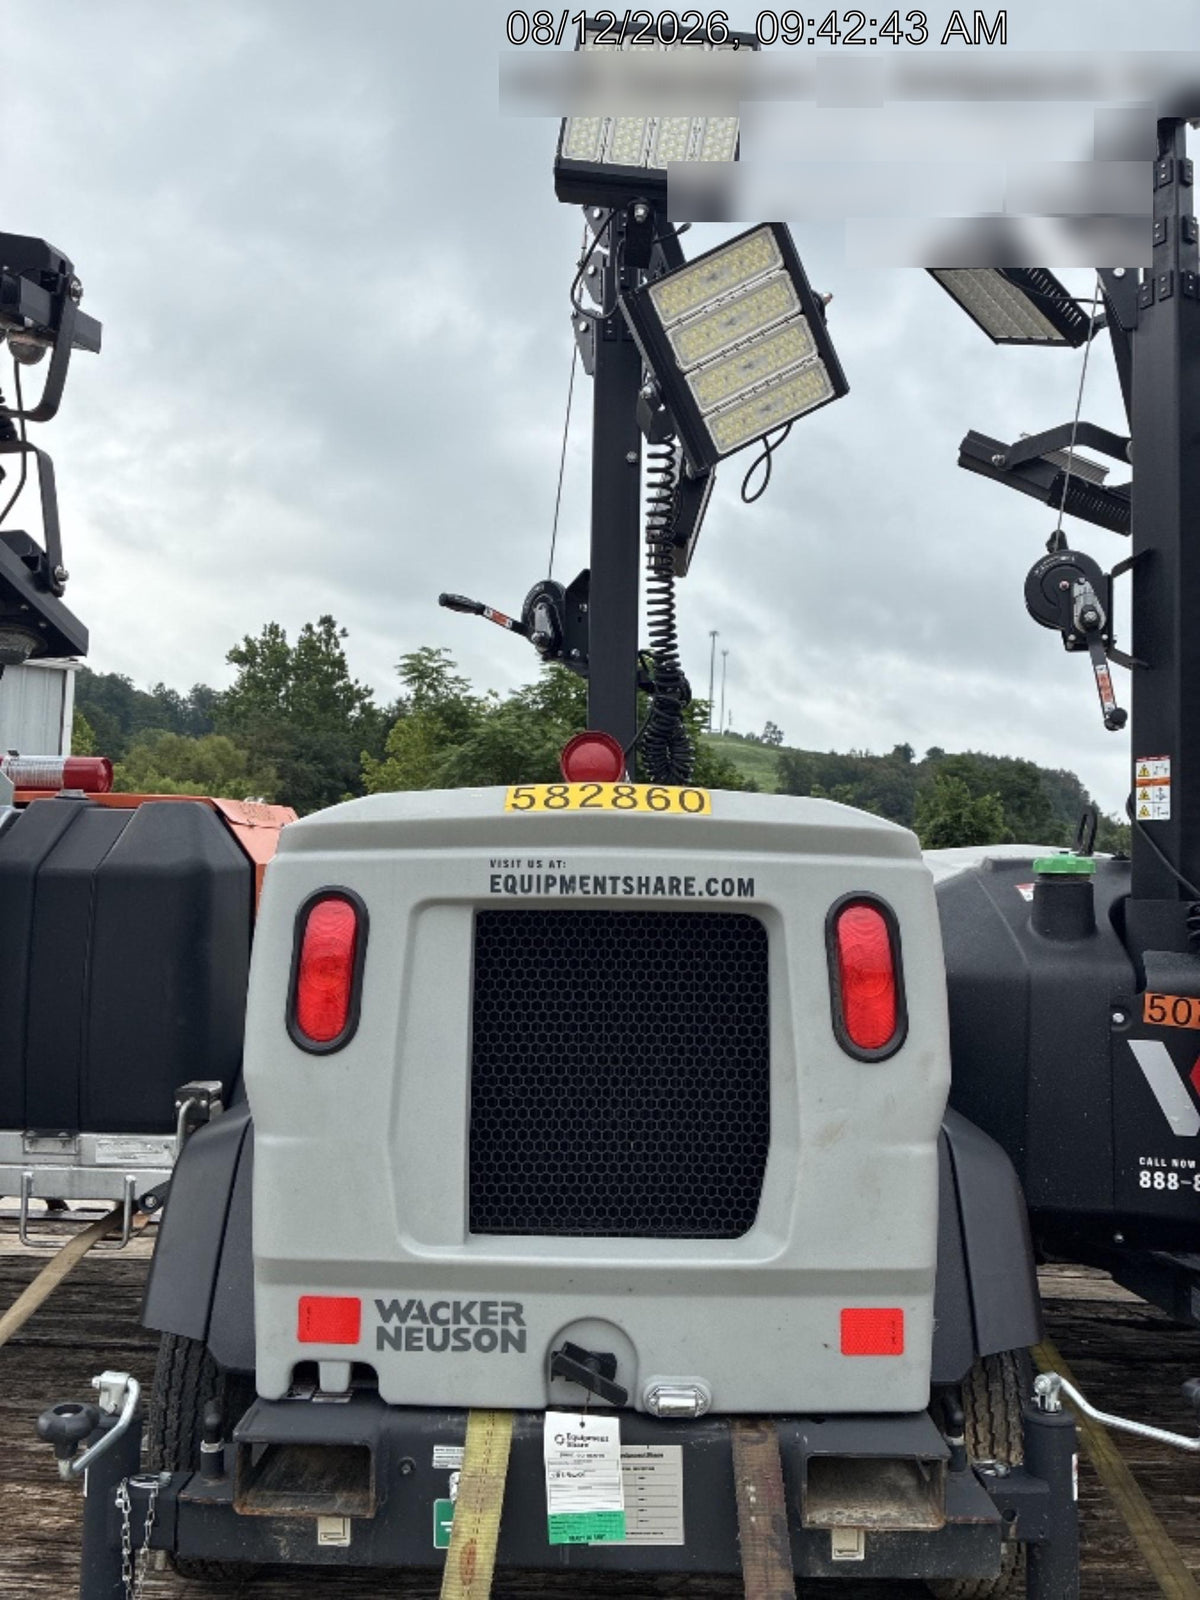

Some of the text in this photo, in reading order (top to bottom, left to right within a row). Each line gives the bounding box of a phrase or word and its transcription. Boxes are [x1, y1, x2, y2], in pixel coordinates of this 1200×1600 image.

[511, 783, 705, 813] 582860
[489, 859, 567, 869] VISIT US AT:
[489, 874, 755, 897] EQUIPMENTSHARE.COM
[1148, 995, 1200, 1025] 50
[1139, 1156, 1196, 1169] CALL NOW
[374, 1299, 527, 1326] WACKER
[376, 1326, 527, 1353] NEUSON
